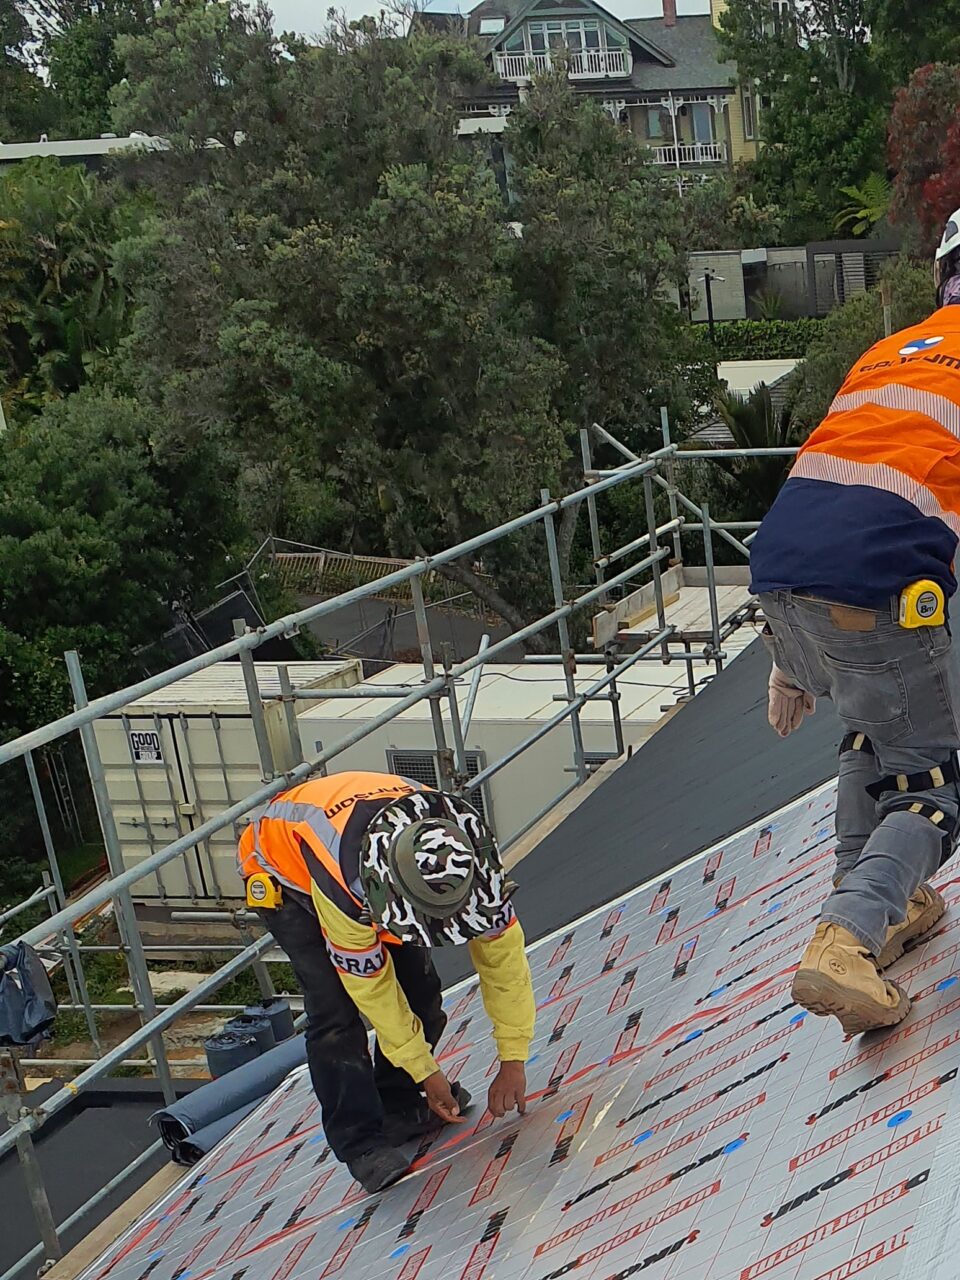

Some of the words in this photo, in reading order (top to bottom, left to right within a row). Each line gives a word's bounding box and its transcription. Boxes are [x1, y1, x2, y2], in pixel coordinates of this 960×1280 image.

[131, 733, 160, 750] GOOD
[595, 1091, 717, 1166] enerterm
[853, 1115, 944, 1176] enerth
[548, 1135, 574, 1163] IKO
[669, 1136, 740, 1181] KO
[480, 1210, 509, 1243] IKO
